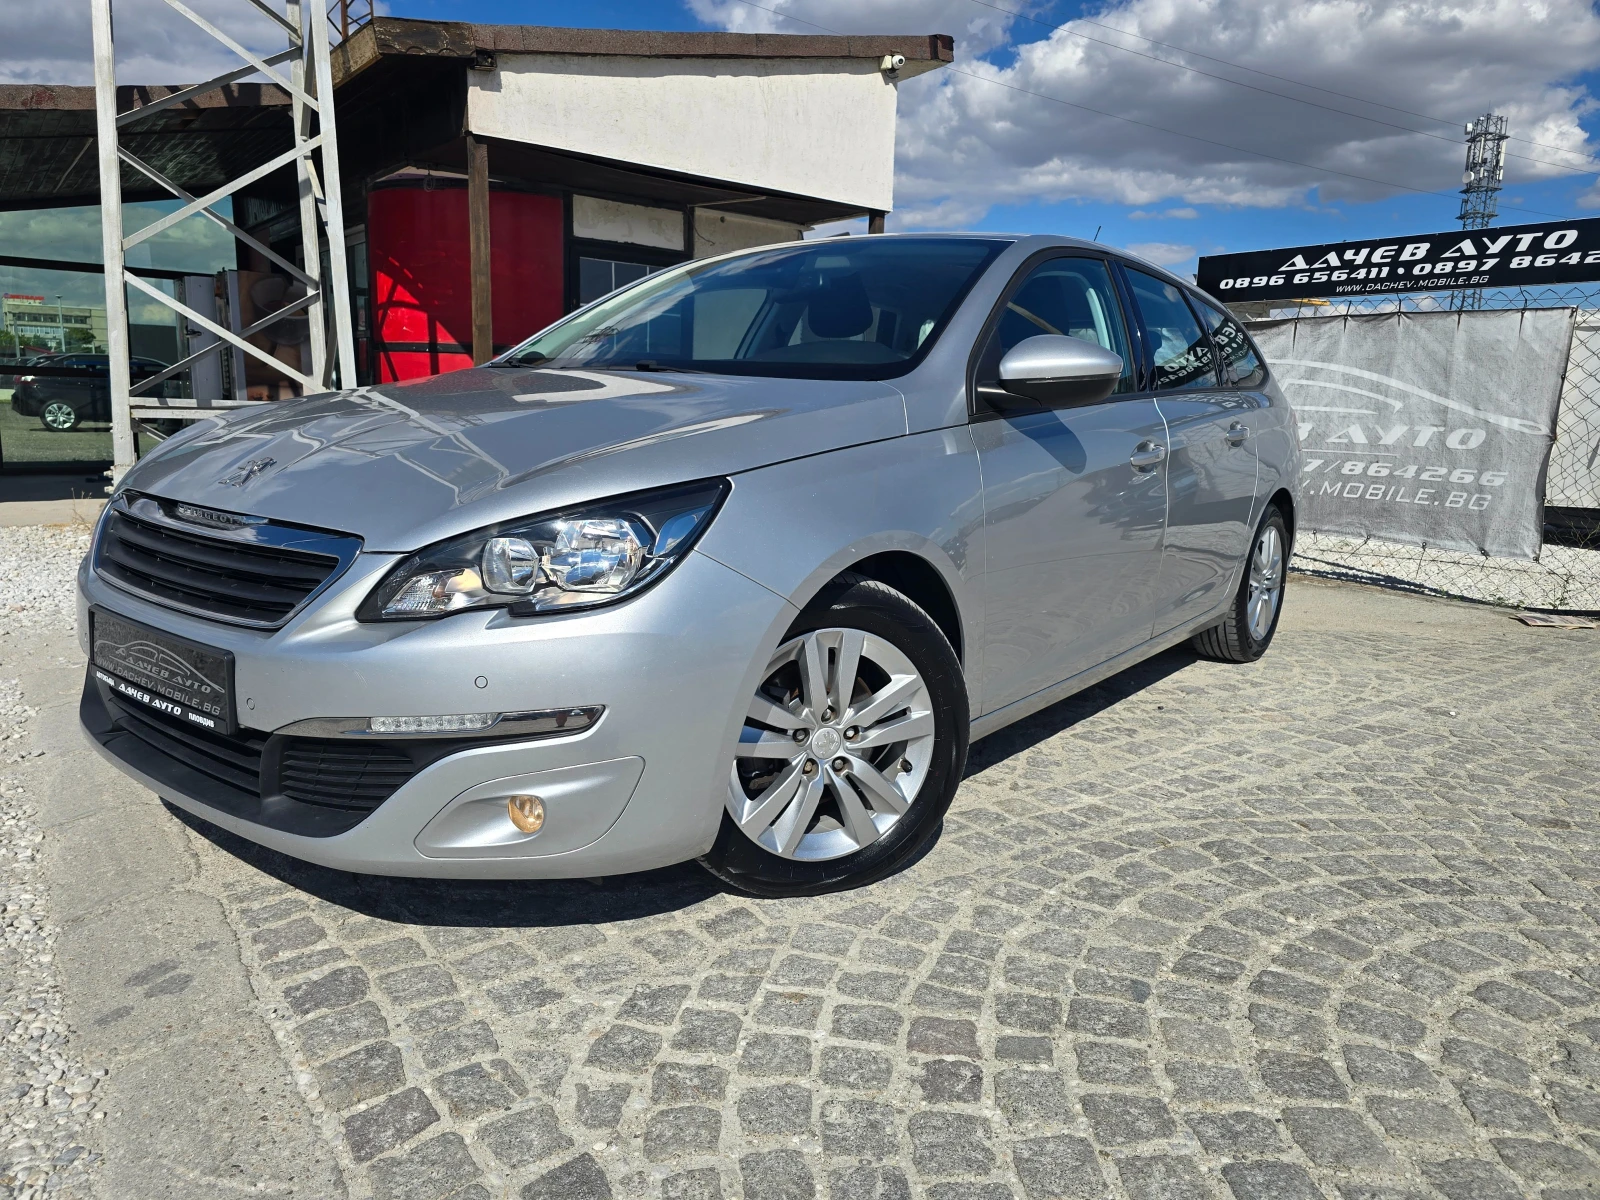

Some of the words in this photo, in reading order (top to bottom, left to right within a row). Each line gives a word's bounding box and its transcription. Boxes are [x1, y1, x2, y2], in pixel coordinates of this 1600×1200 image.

[1278, 243, 1431, 271] ДАЧЕВ
[1440, 229, 1579, 258] АУТО
[1219, 274, 1286, 290] 0896
[1293, 266, 1390, 284] 656411
[1411, 258, 1500, 276] 0897
[1335, 275, 1490, 294] WWW.DACHEV.MOBILE.BG
[1325, 423, 1487, 450] АУТО
[126, 656, 170, 679] ДАЧЕВ
[172, 675, 212, 694] АУТО
[118, 683, 151, 703] ДАЧЕВ
[151, 699, 182, 716] АУТО
